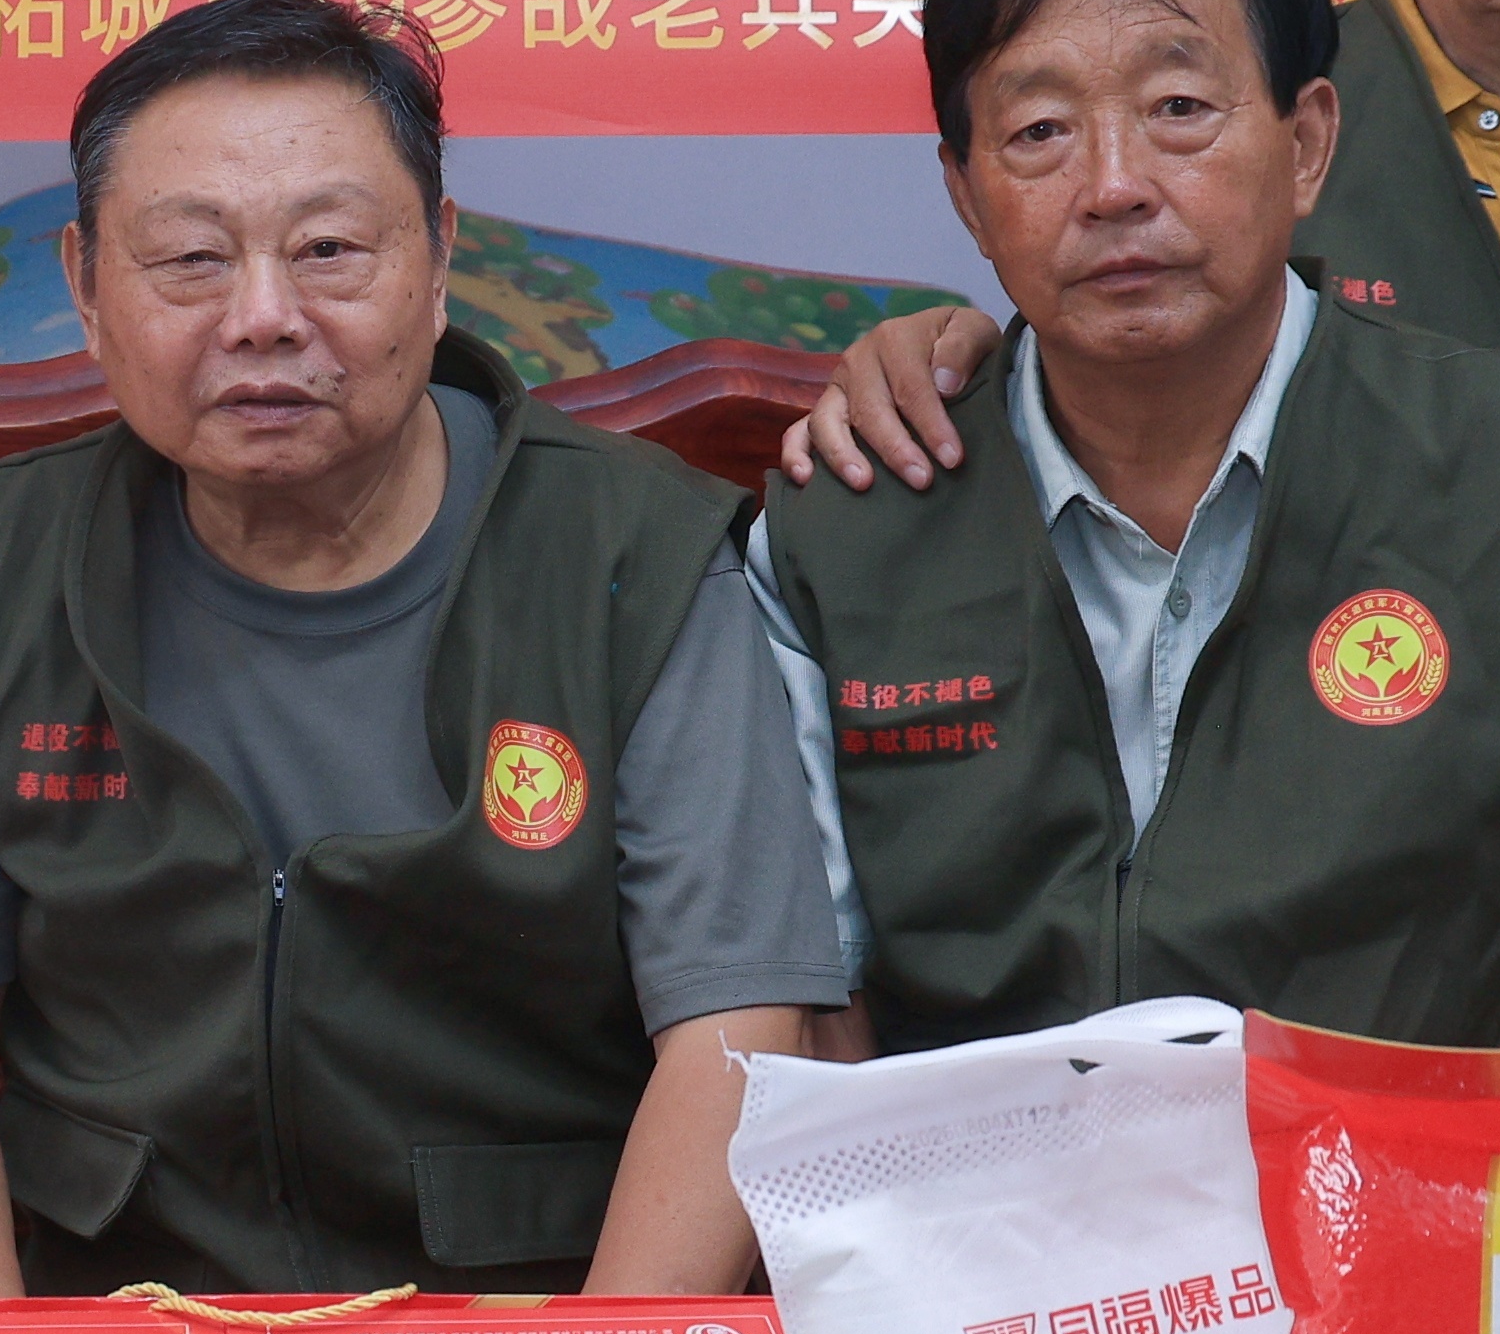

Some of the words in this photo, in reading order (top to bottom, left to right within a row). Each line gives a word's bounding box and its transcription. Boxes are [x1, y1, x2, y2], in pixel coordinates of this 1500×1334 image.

[1333, 276, 1397, 306] 褪色
[839, 674, 996, 710] 退役不褪色
[840, 720, 999, 756] 奉献新时代
